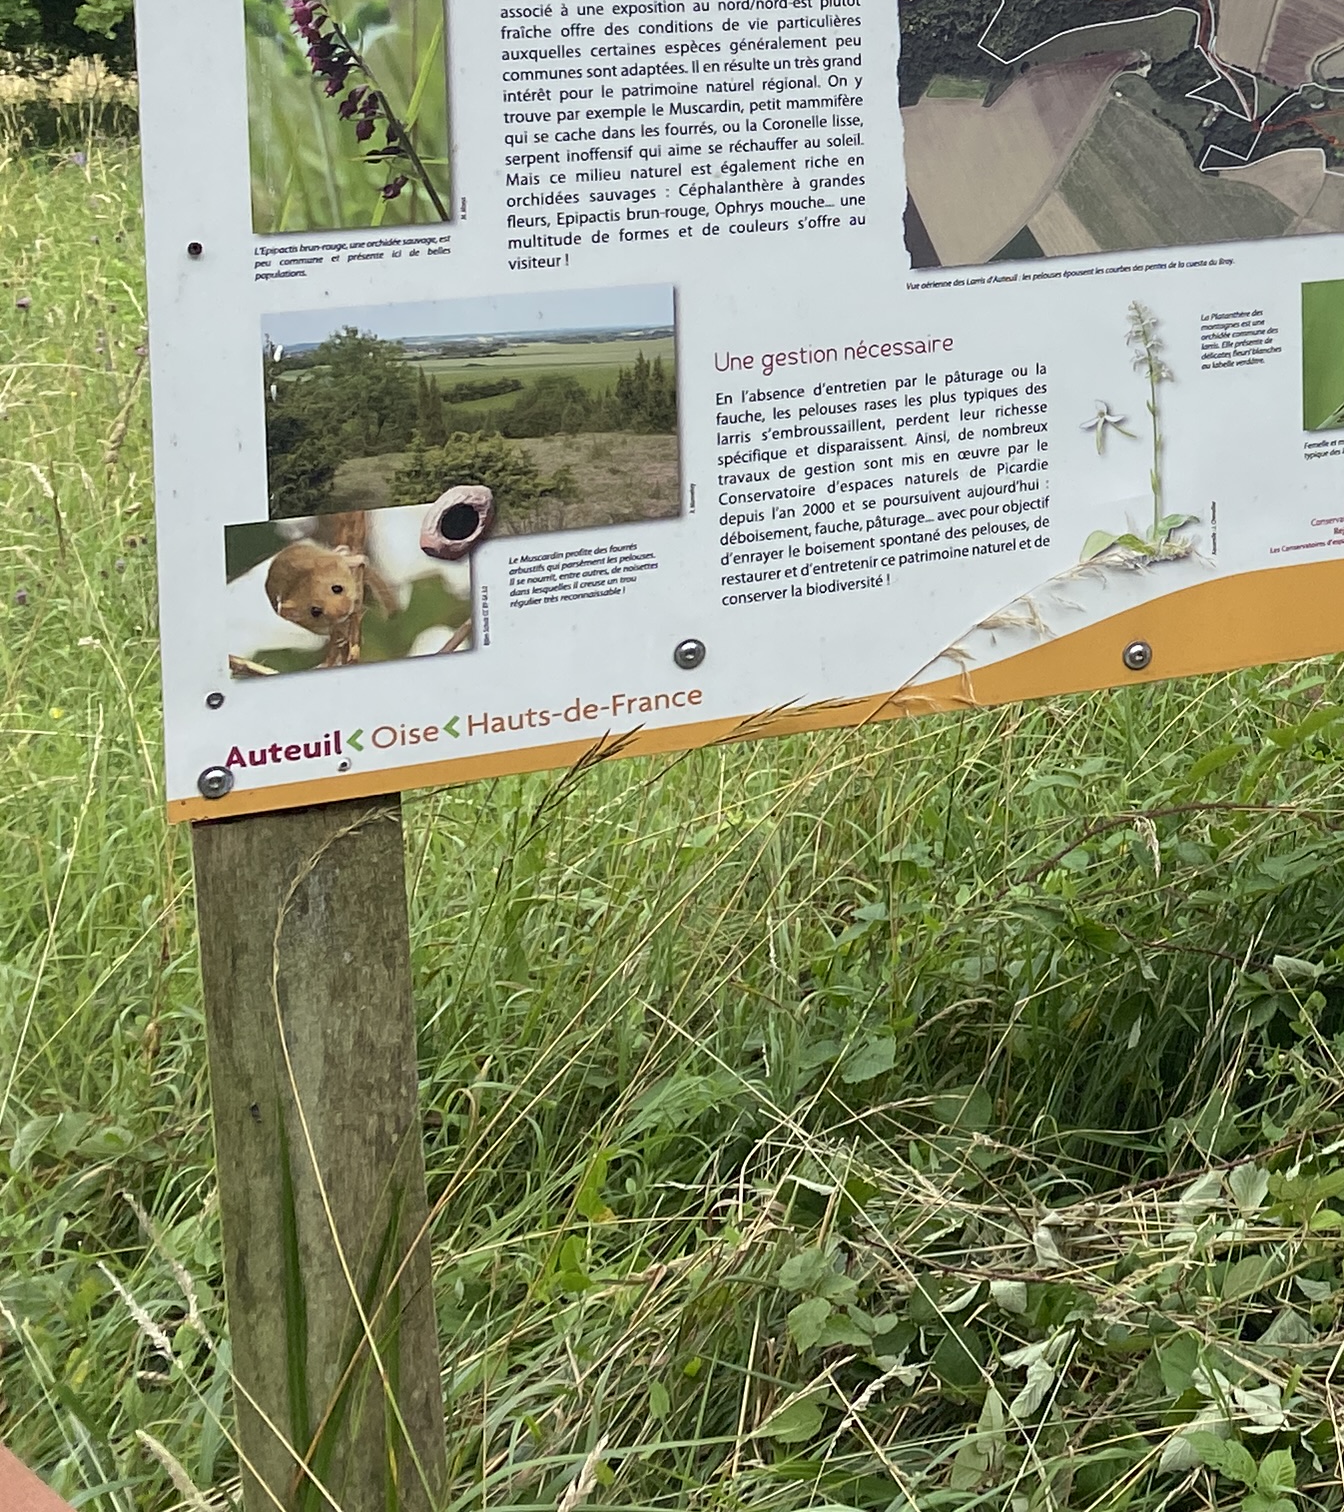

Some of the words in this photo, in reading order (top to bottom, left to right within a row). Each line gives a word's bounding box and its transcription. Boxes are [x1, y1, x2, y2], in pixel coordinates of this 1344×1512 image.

[500, 3, 553, 19] associé
[560, 3, 569, 17] à
[576, 5, 605, 16] une
[612, 0, 685, 18] exposition
[692, 1, 710, 13] au
[500, 24, 552, 40] fraîche
[560, 22, 595, 38] offre
[604, 21, 630, 36] des
[638, 19, 714, 35] conditions
[721, 17, 740, 32] de
[747, 17, 769, 31] vie
[777, 14, 862, 33] particulières
[501, 44, 582, 63] auxquelles
[590, 42, 656, 58] certaines
[664, 39, 721, 58] espèces
[729, 35, 828, 55] généralement
[835, 36, 862, 51] peu
[714, 351, 754, 372] Une
[761, 343, 838, 377] gestion
[844, 333, 954, 361] nécessaire
[715, 392, 733, 406] En
[741, 387, 805, 403] l'absence
[813, 378, 887, 397] d'entretien
[895, 376, 918, 392] par
[925, 372, 937, 386] le
[944, 369, 1004, 388] pâturage
[1011, 366, 1028, 378] ou
[1035, 362, 1047, 376] la
[772, 406, 792, 420] les
[798, 402, 858, 422] pelouses
[864, 398, 898, 411] rases
[904, 393, 923, 408] les
[929, 390, 957, 409] plus
[963, 386, 1019, 405] typiques
[1025, 381, 1047, 396] des
[717, 430, 752, 446] larris
[896, 411, 950, 431] perdent
[959, 407, 986, 422] leur
[995, 402, 1048, 418] richesse
[717, 448, 788, 469] spécifique
[795, 445, 810, 458] et
[958, 426, 975, 441] de
[982, 421, 1048, 439] nombreux
[226, 730, 342, 769] Auteuil
[372, 724, 439, 750] Oise
[468, 689, 703, 737] Hauts-de-France
